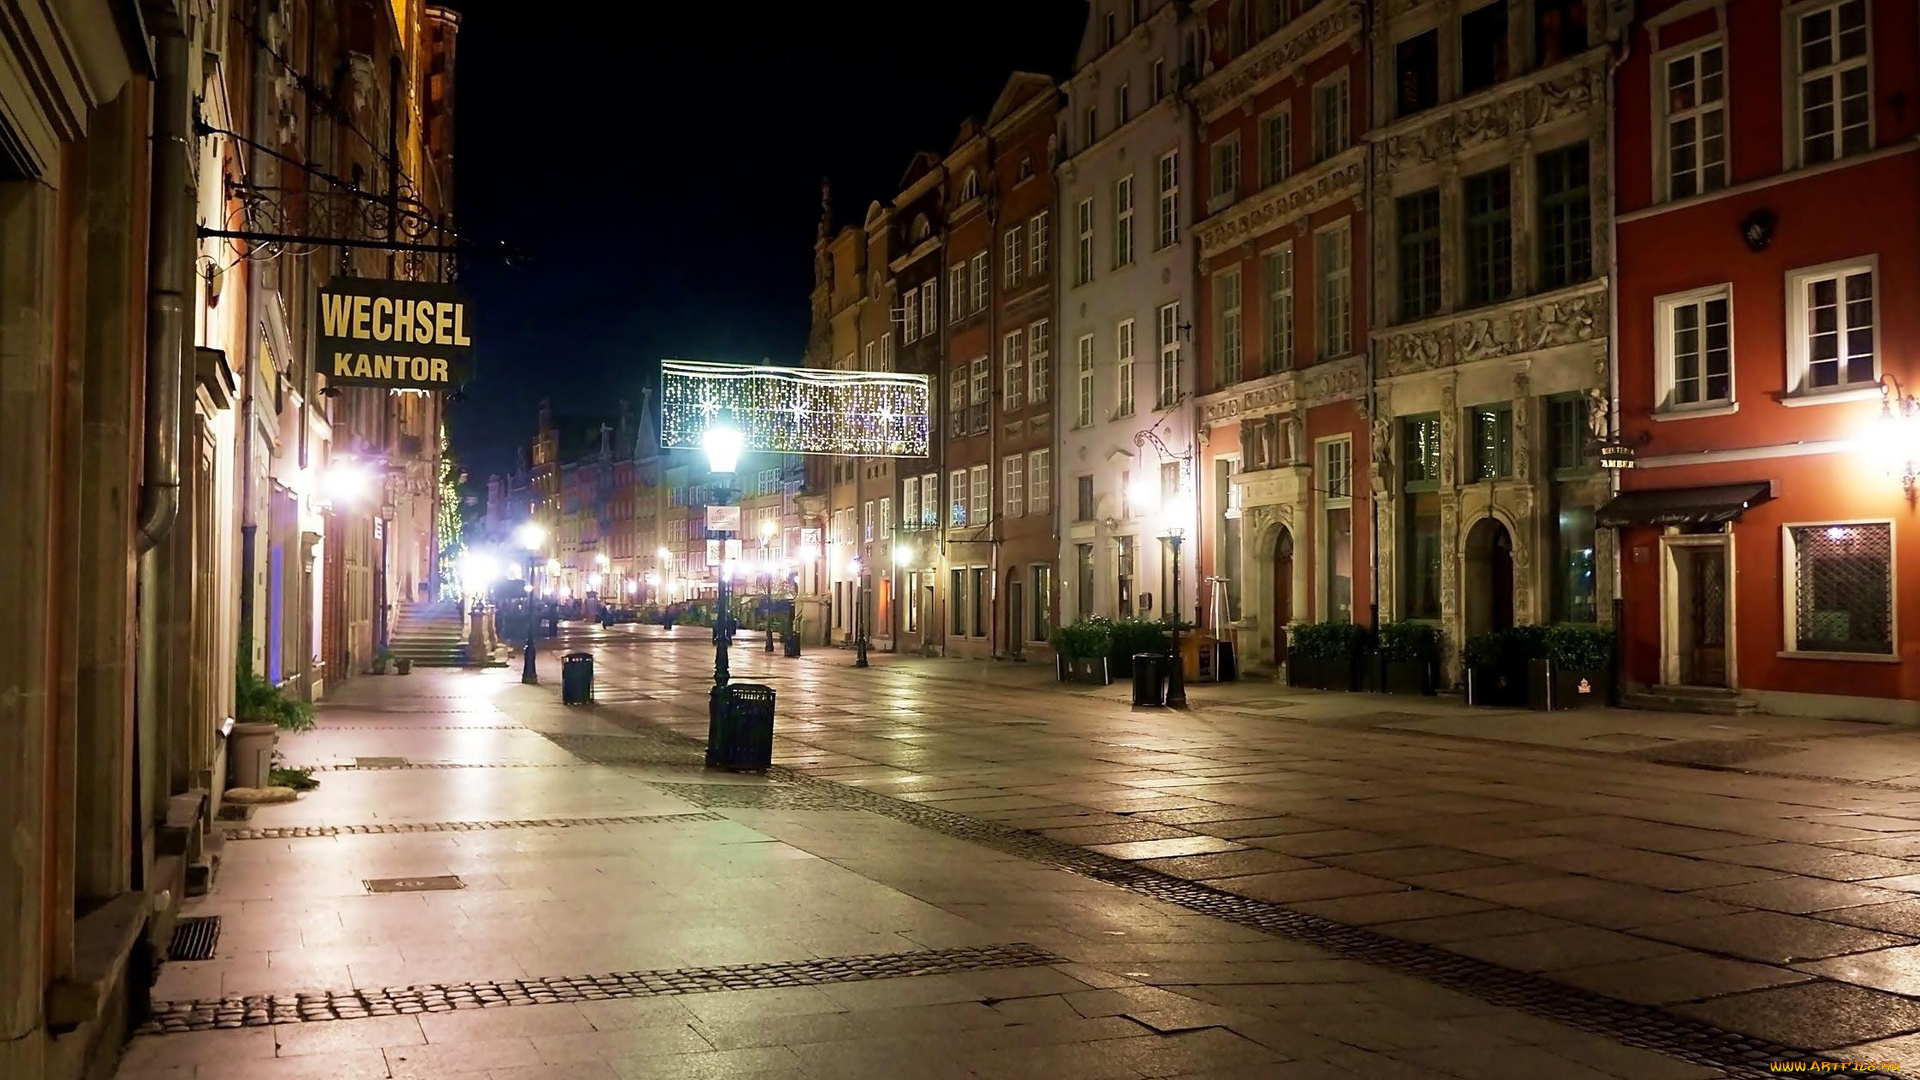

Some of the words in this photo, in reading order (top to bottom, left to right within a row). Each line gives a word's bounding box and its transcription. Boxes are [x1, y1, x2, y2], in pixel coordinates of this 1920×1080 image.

[321, 293, 470, 346] WECHSEL
[334, 352, 448, 382] KANTOR
[1600, 459, 1634, 469] AMBER
